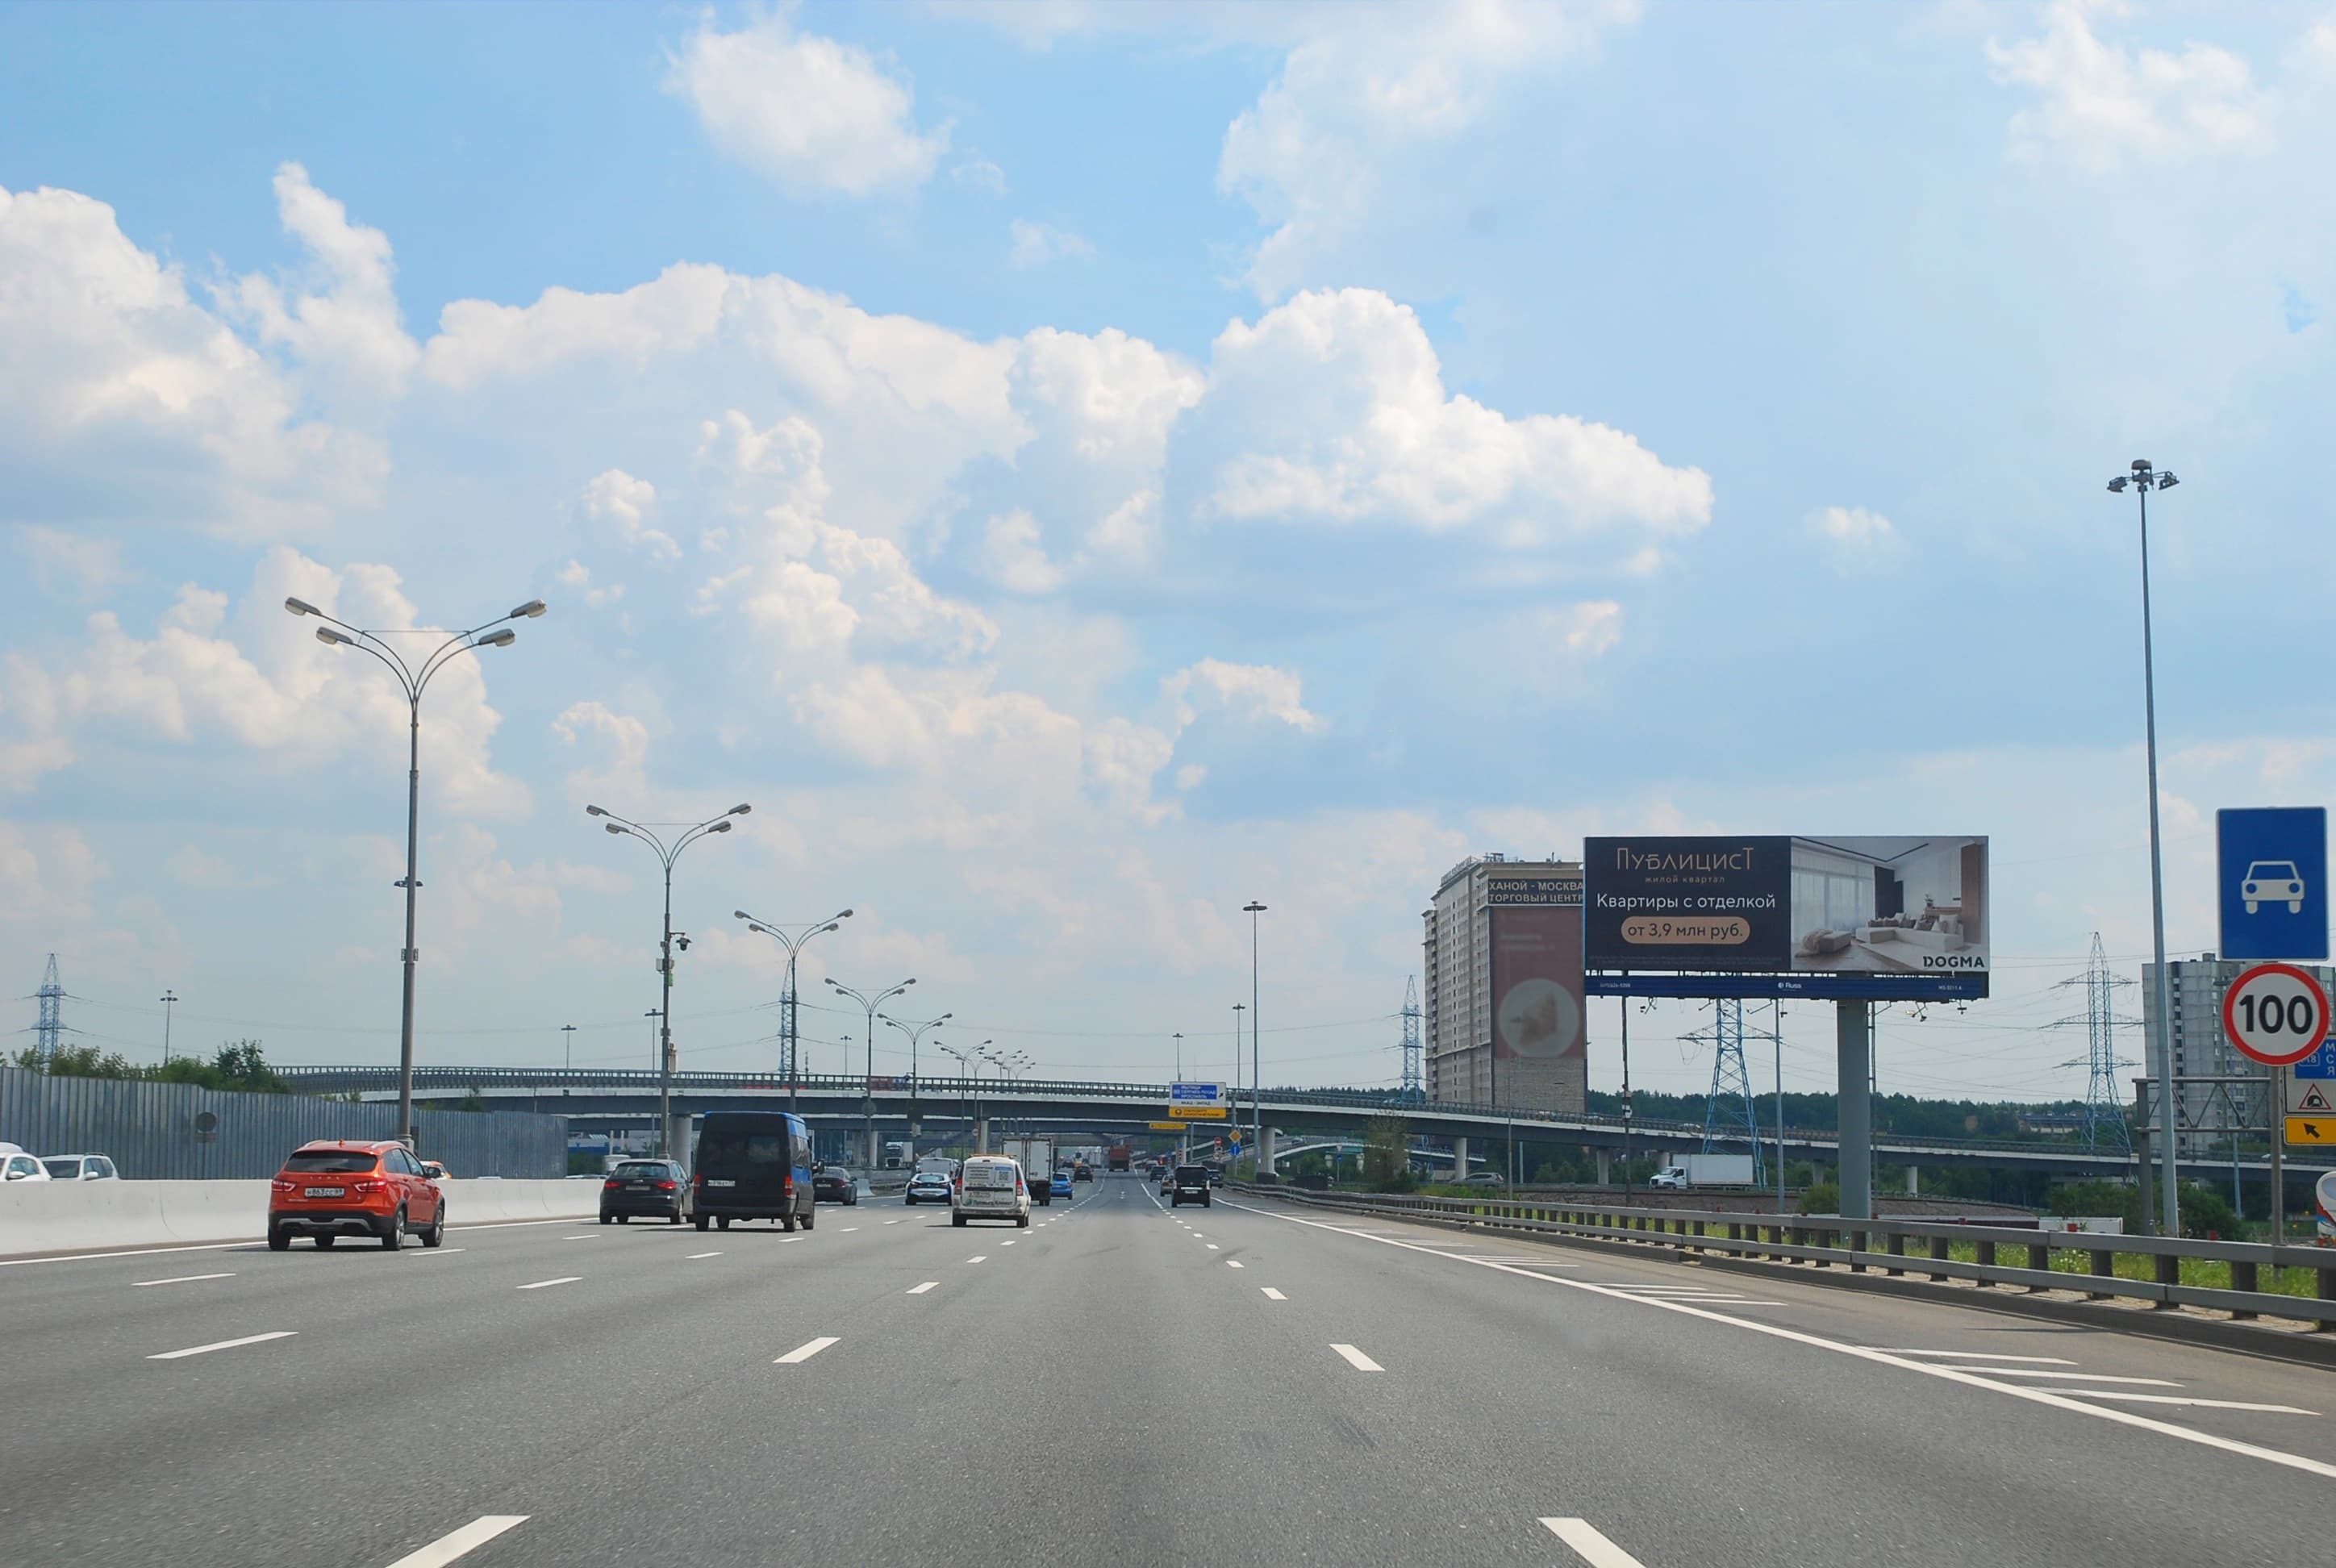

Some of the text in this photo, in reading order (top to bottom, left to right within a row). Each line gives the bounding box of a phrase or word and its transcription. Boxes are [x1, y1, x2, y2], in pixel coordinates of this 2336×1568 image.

[1489, 880, 1528, 891] ХАНОЙ
[1538, 882, 1583, 891] МОСКВА
[1645, 875, 1725, 884] жилой квартал
[1489, 893, 1547, 902] ТОРГОВЫЙ
[1596, 893, 1775, 911] Квартиры с отделкой
[1628, 923, 1743, 940] от 3,9 млн руб.
[1922, 956, 1984, 968] DOGMA
[2239, 995, 2313, 1034] 100
